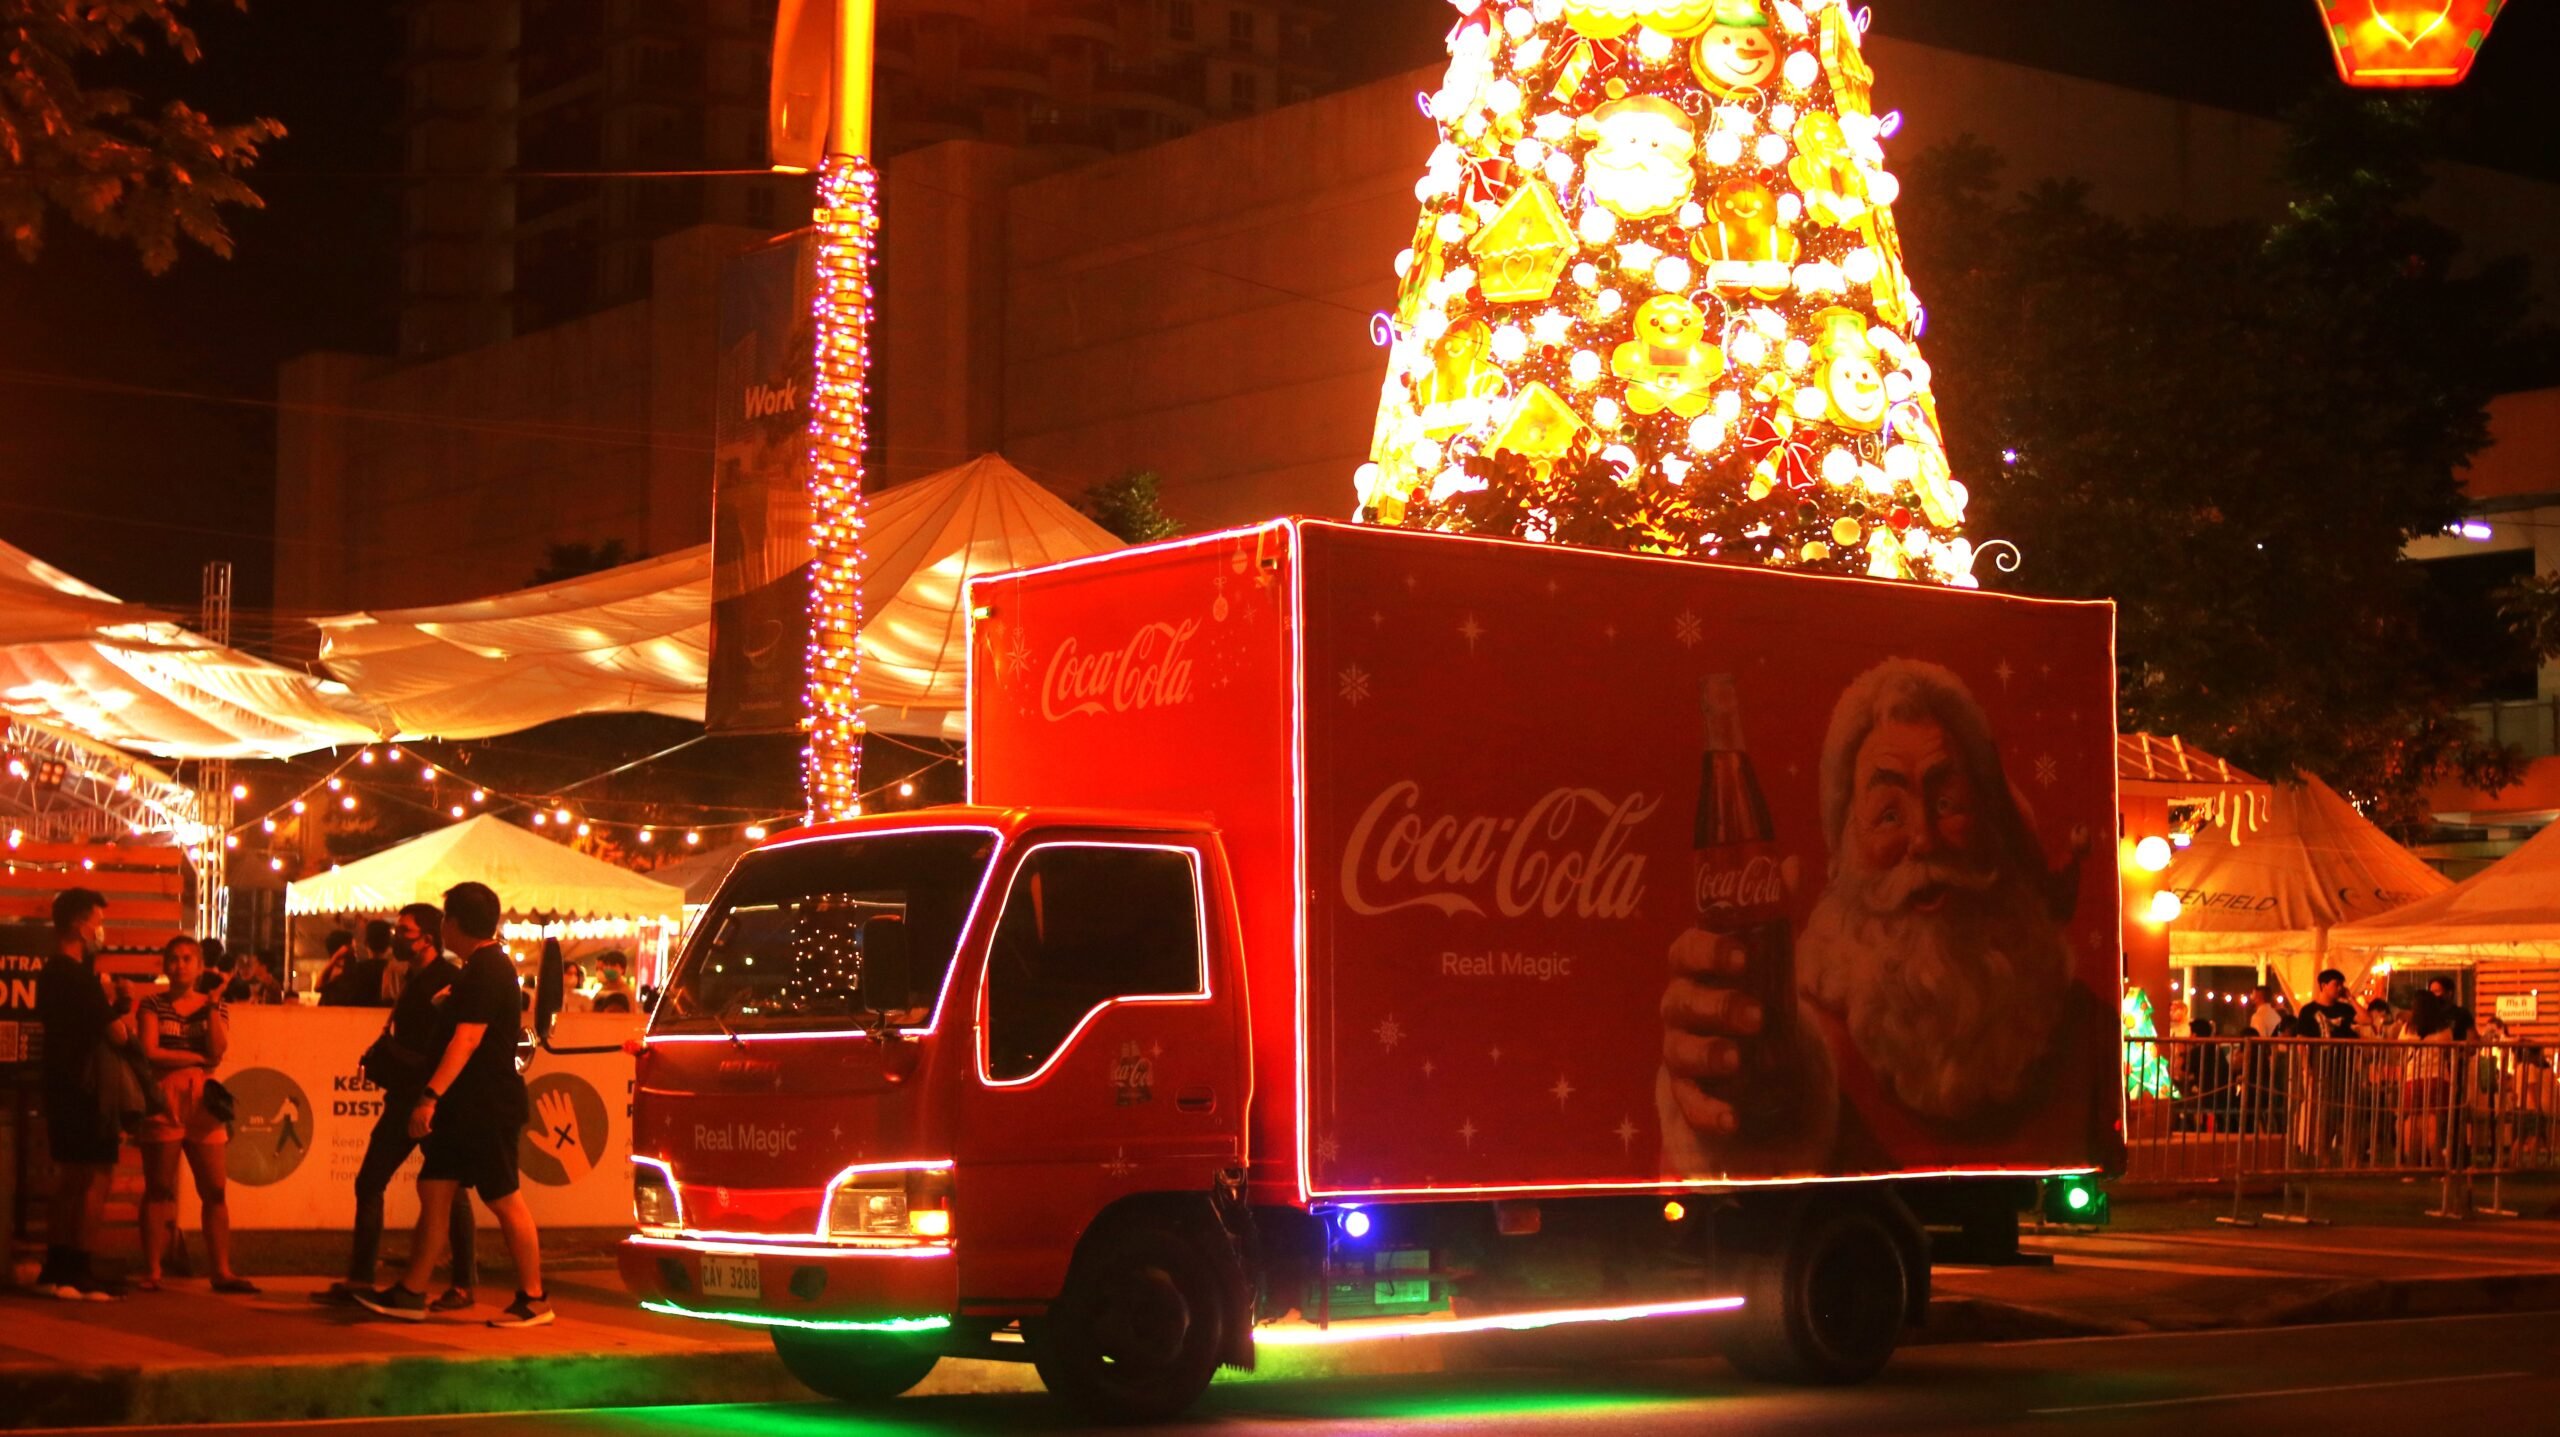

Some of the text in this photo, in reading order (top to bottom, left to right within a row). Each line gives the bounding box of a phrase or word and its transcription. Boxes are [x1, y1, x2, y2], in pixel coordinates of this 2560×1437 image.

[745, 377, 797, 420] Work
[1041, 617, 1202, 722] Coca-Cola
[1341, 780, 1663, 919] Coca-Cola
[1696, 856, 1781, 913] Coca-Cola
[1441, 951, 1571, 981] Real Magic
[333, 1075, 379, 1091] KEE
[333, 1100, 383, 1116] DIST
[332, 1136, 364, 1151] Keep
[694, 1122, 797, 1157] Real Magic
